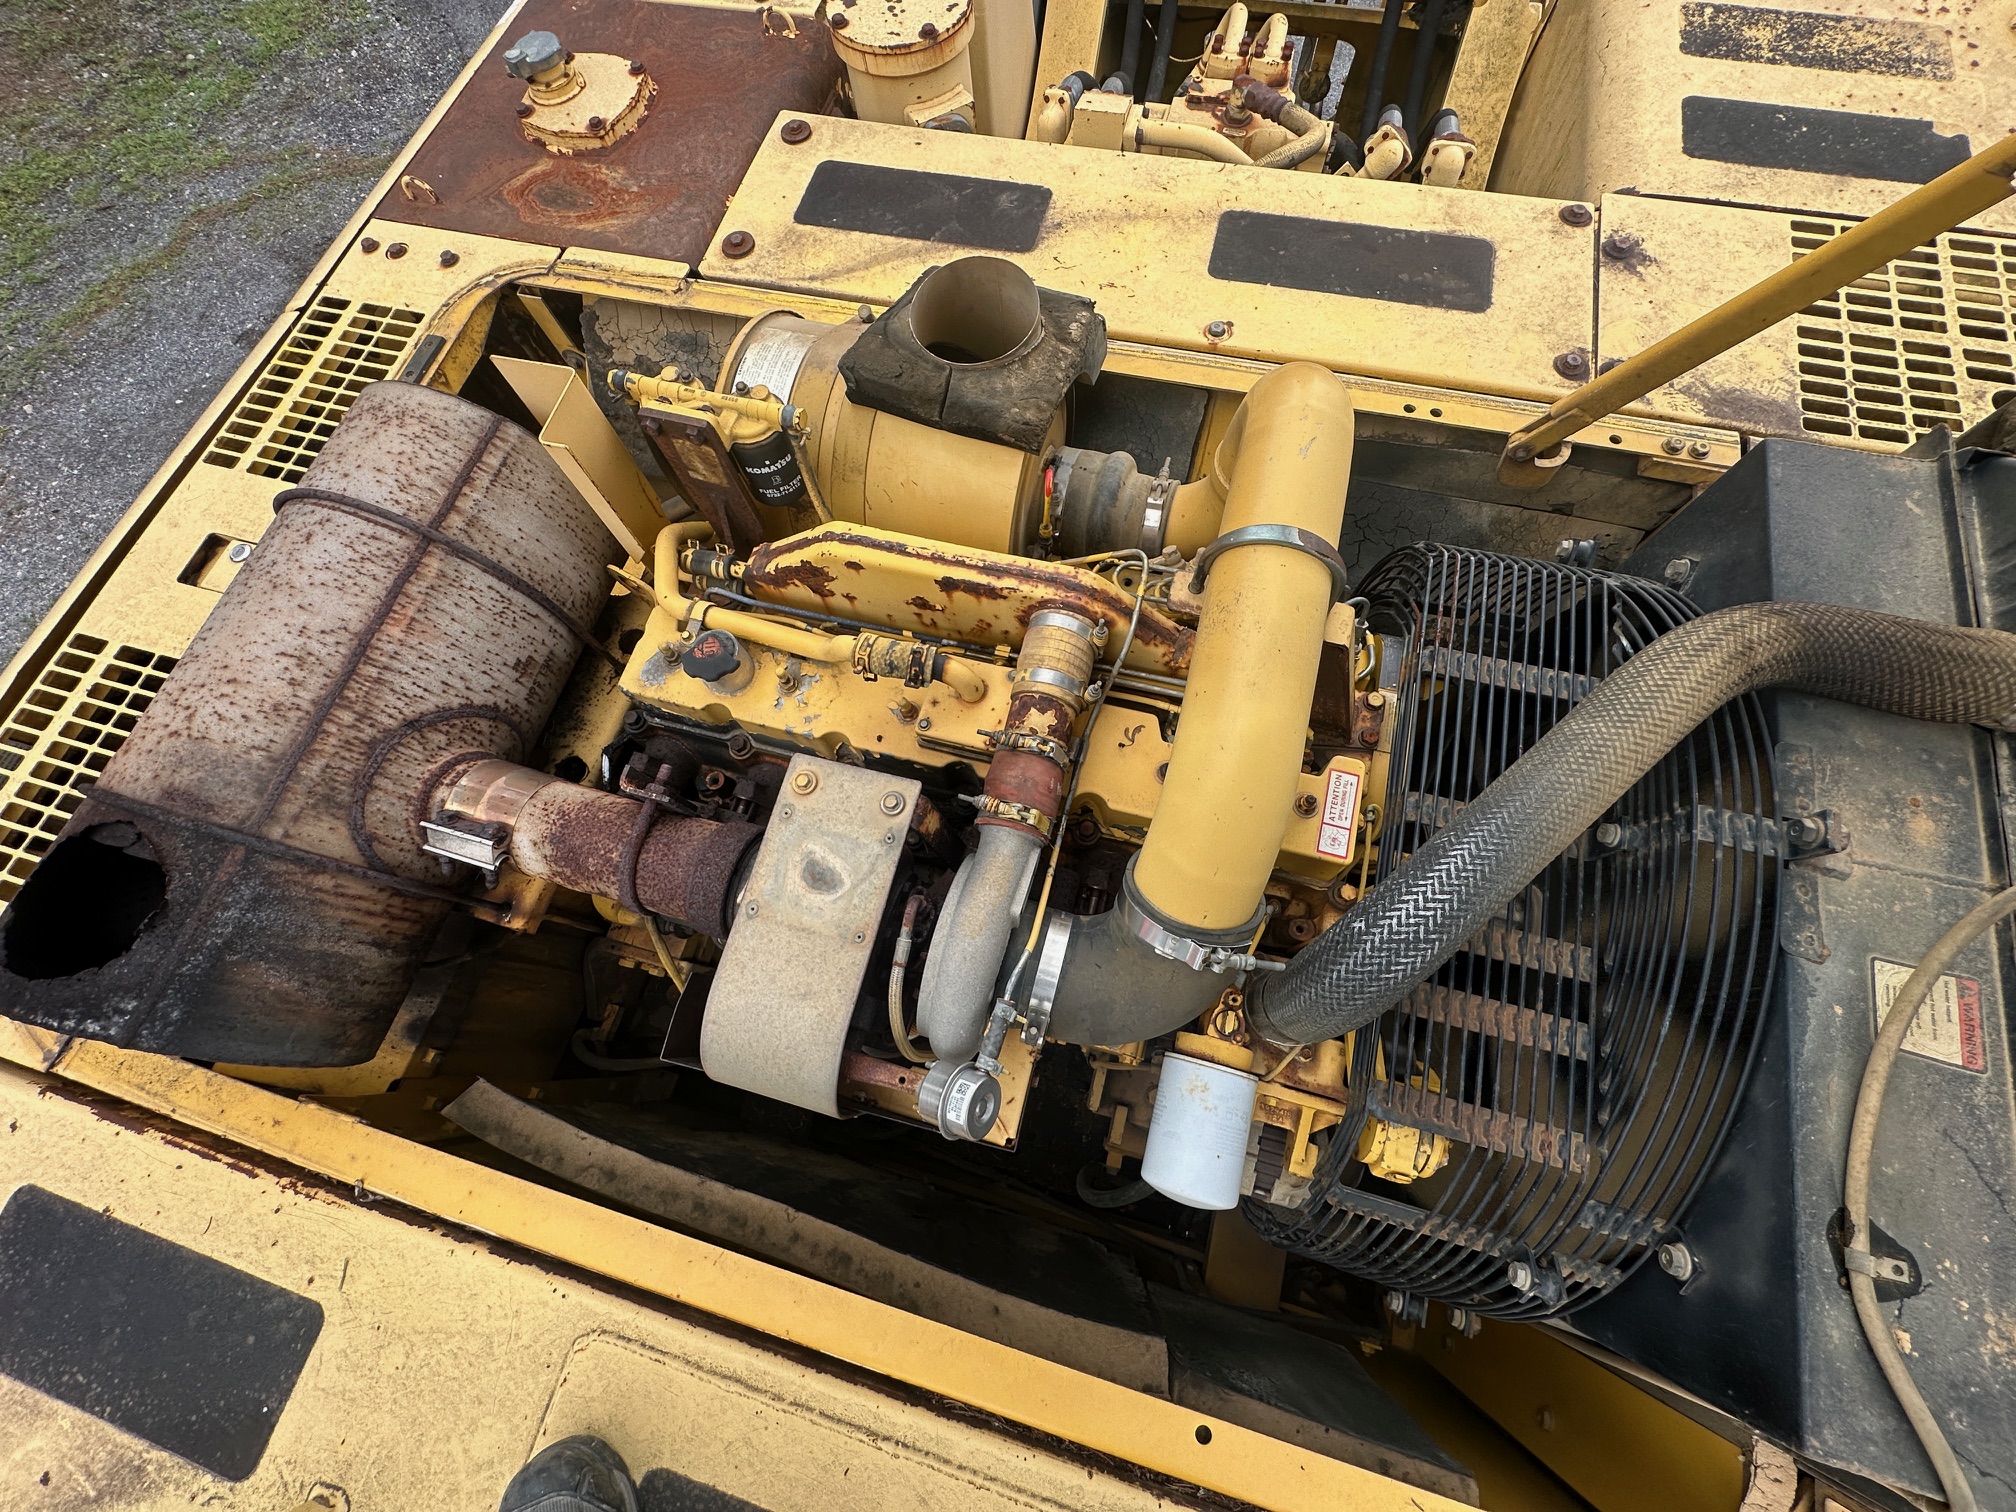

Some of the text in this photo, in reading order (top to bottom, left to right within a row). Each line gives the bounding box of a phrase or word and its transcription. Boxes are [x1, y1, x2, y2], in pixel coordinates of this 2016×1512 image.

[745, 454, 791, 474] KOMATSU
[759, 475, 802, 495] FUEL FILTER
[1329, 774, 1343, 822] ATTENTION
[1340, 791, 1348, 808] DURING
[1963, 1002, 1978, 1065] WARNING
